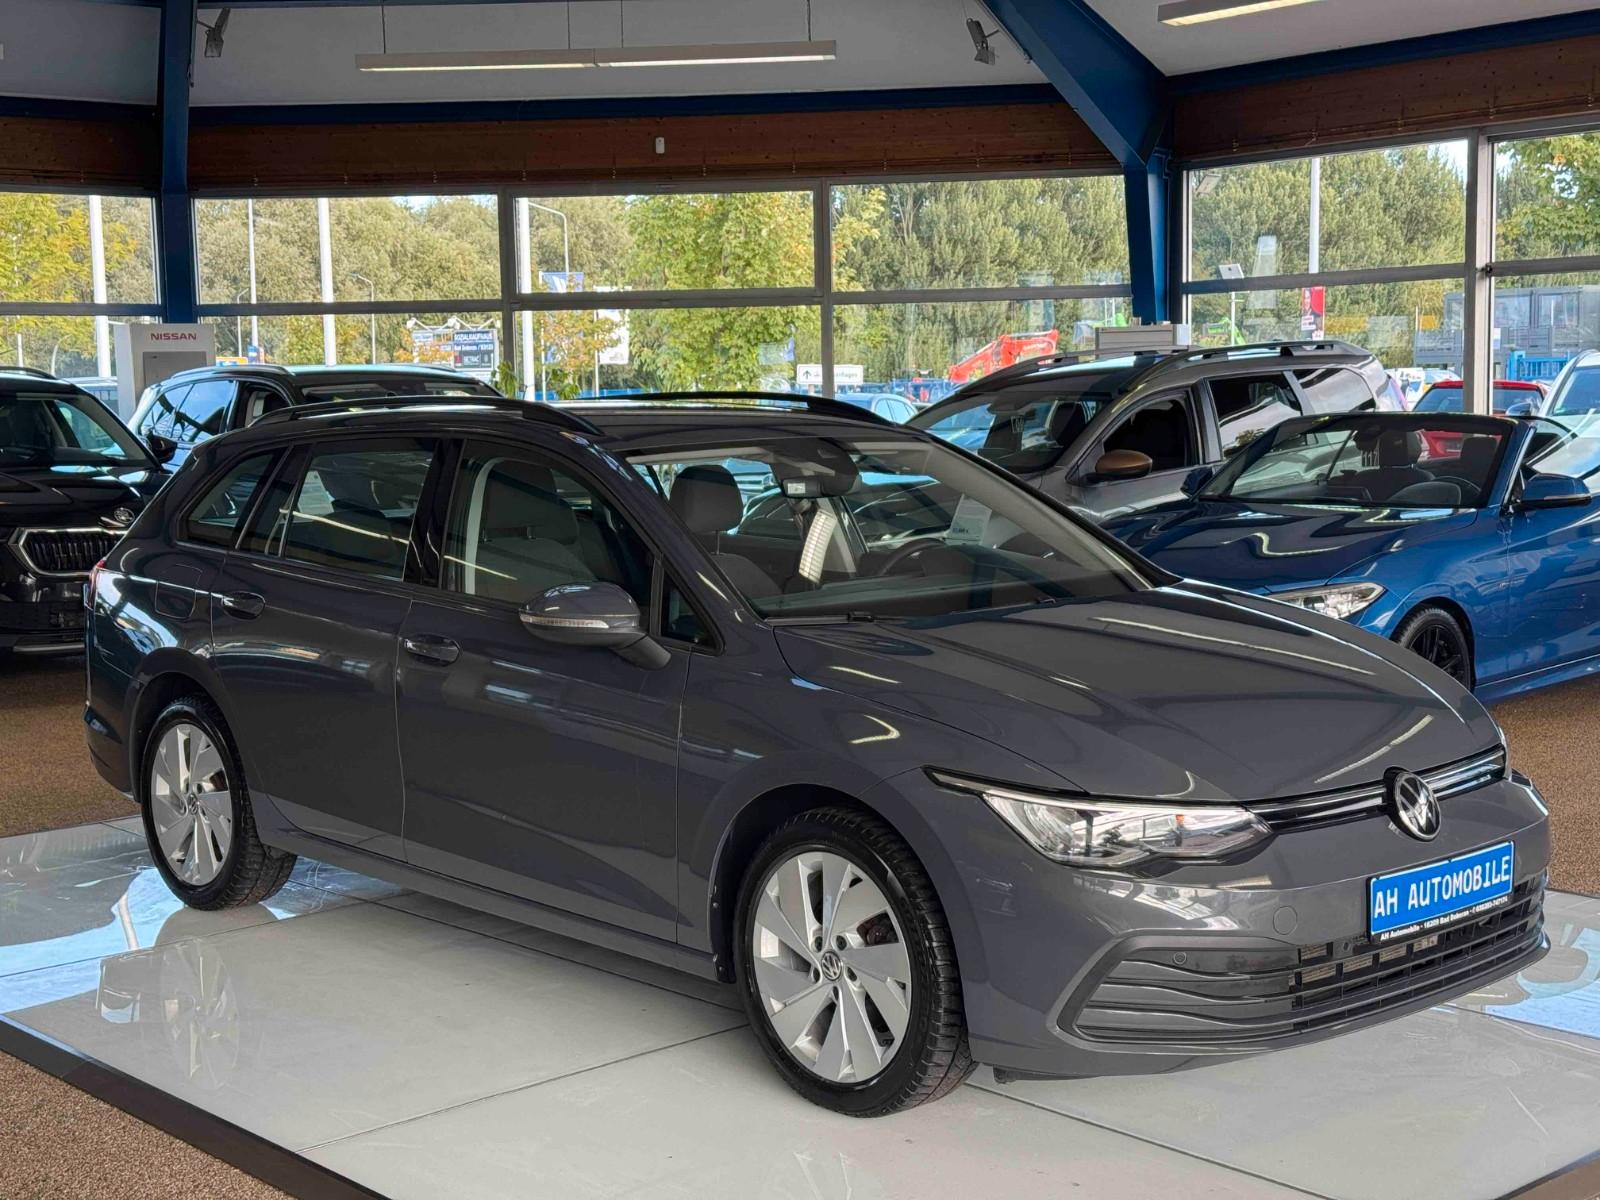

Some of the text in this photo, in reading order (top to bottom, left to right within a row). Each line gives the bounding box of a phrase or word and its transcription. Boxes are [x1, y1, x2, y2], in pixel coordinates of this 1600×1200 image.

[150, 332, 197, 341] NISSAN
[1374, 855, 1511, 919] AH AUTOMOBILE
[1380, 931, 1390, 941] AH
[1390, 925, 1420, 938] Automobile
[1439, 915, 1451, 925] Bad
